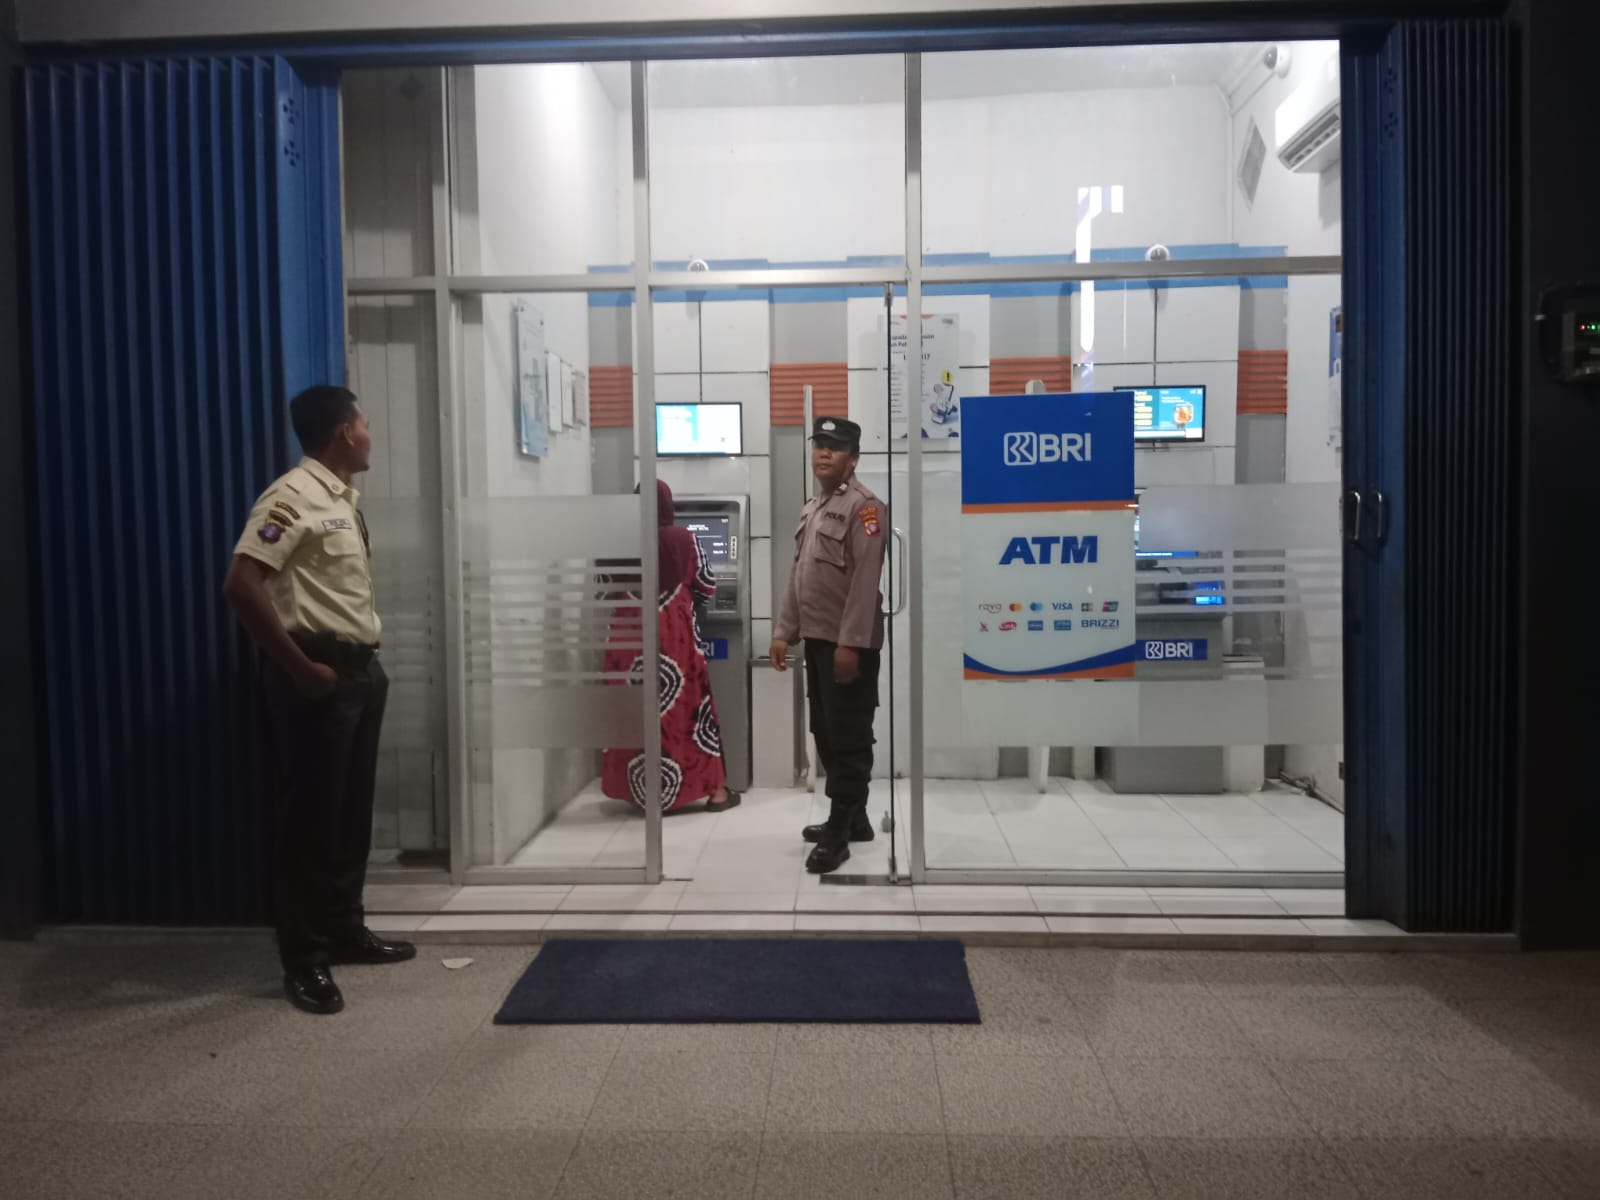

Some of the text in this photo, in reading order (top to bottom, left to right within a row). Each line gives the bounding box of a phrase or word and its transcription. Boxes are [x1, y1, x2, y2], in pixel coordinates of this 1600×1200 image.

[1039, 432, 1092, 463] BRI
[998, 535, 1098, 565] ATM
[1051, 602, 1073, 611] VISA
[1081, 619, 1120, 629] BRIZZI
[700, 641, 715, 657] RI
[1165, 642, 1193, 658] BRI
